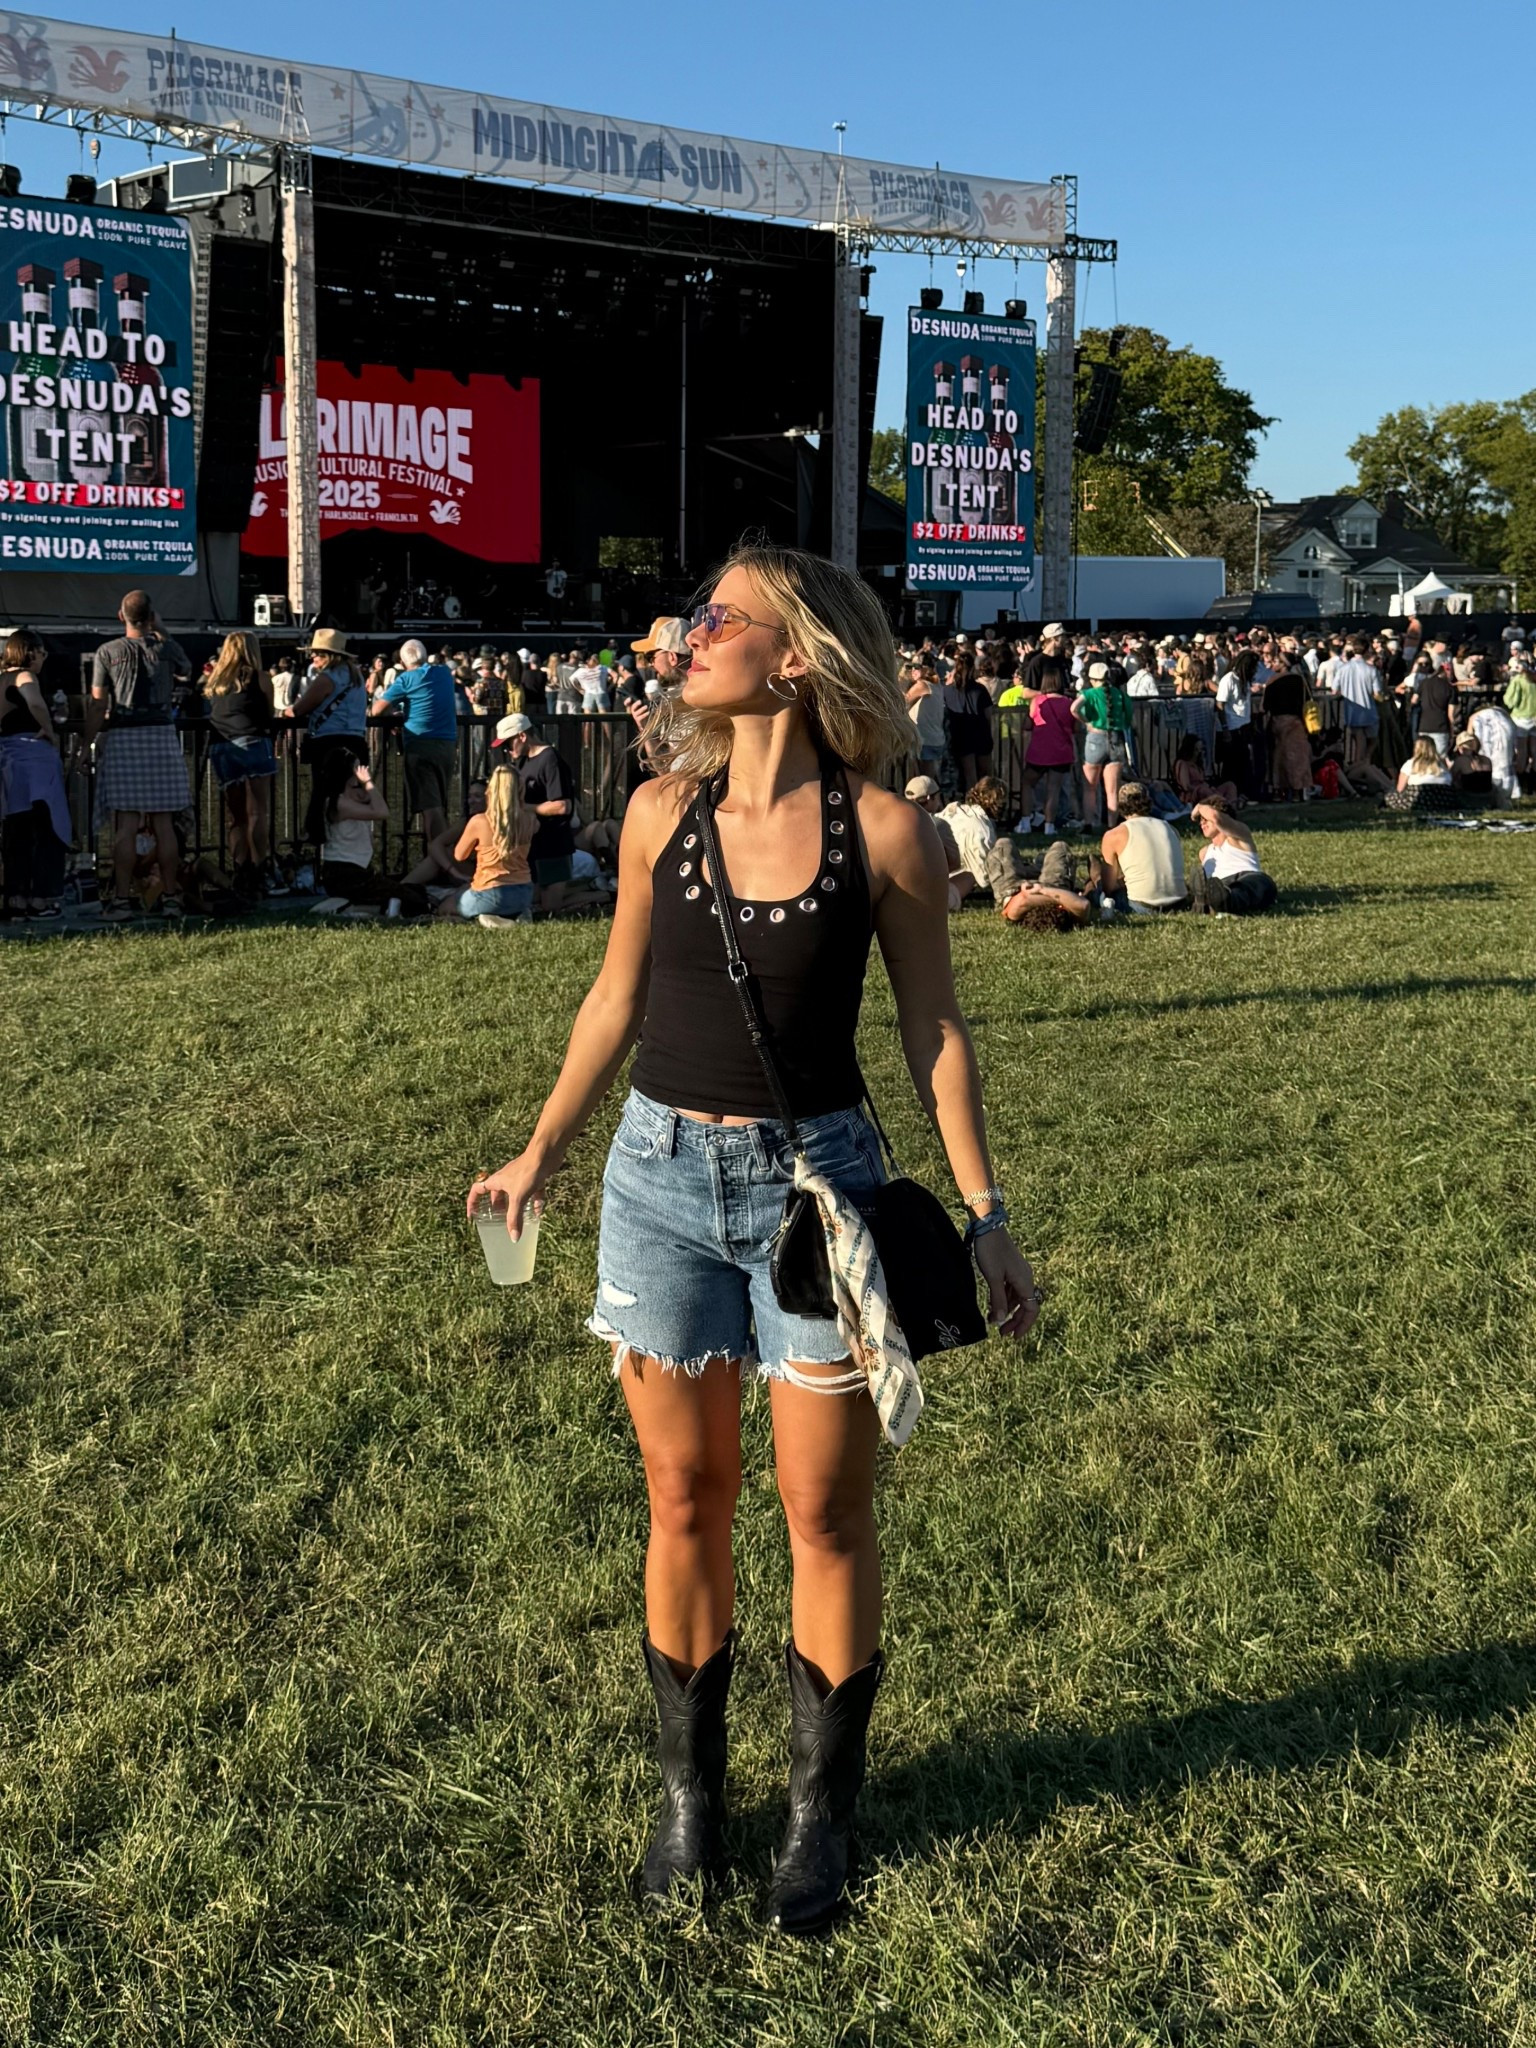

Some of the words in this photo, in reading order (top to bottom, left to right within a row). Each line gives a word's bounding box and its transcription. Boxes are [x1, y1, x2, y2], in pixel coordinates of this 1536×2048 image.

[147, 48, 304, 113] PILGRIMAGE
[472, 108, 637, 177] MIDNIGHT
[681, 143, 743, 194] SUN
[870, 169, 972, 216] PILGRIMAGE
[97, 218, 144, 234] ORGANIC
[145, 224, 188, 240] TEQUILA
[98, 232, 123, 243] 100%
[127, 236, 152, 246] PURE
[157, 241, 188, 251] AGAVE
[910, 317, 980, 341] DESNUDA
[981, 324, 1008, 335] ORGANIC
[9, 321, 109, 359] HEAD
[122, 332, 167, 366] TO
[927, 404, 984, 431] HEAD
[992, 409, 1018, 434] TO
[45, 428, 137, 464] TENT
[911, 442, 1032, 473] DESNUDA'S
[0, 478, 26, 501] $2
[35, 483, 79, 503] OFF
[388, 463, 453, 497] FESTIVAL
[319, 478, 381, 509] 2025
[945, 483, 999, 509] TENT
[1, 512, 13, 523] By
[15, 513, 48, 525] signing
[50, 516, 62, 525] up
[64, 516, 80, 525] and
[82, 516, 113, 527] joining
[114, 519, 129, 527] our
[131, 519, 163, 529] mailing
[164, 519, 179, 529] list
[324, 509, 370, 521] HARLINSDALE
[916, 522, 934, 539] $2
[938, 523, 964, 539] OFF
[2, 535, 103, 560] ESNUDA
[103, 538, 150, 551] ORGANIC
[152, 540, 194, 553] TEQUILA
[104, 552, 130, 562] 100%
[134, 552, 158, 562] PURE
[163, 553, 194, 563] AGAVE
[907, 563, 976, 581] DESNUDA
[977, 565, 1005, 573] ORGANIC
[1005, 566, 1031, 575] TEQUILA
